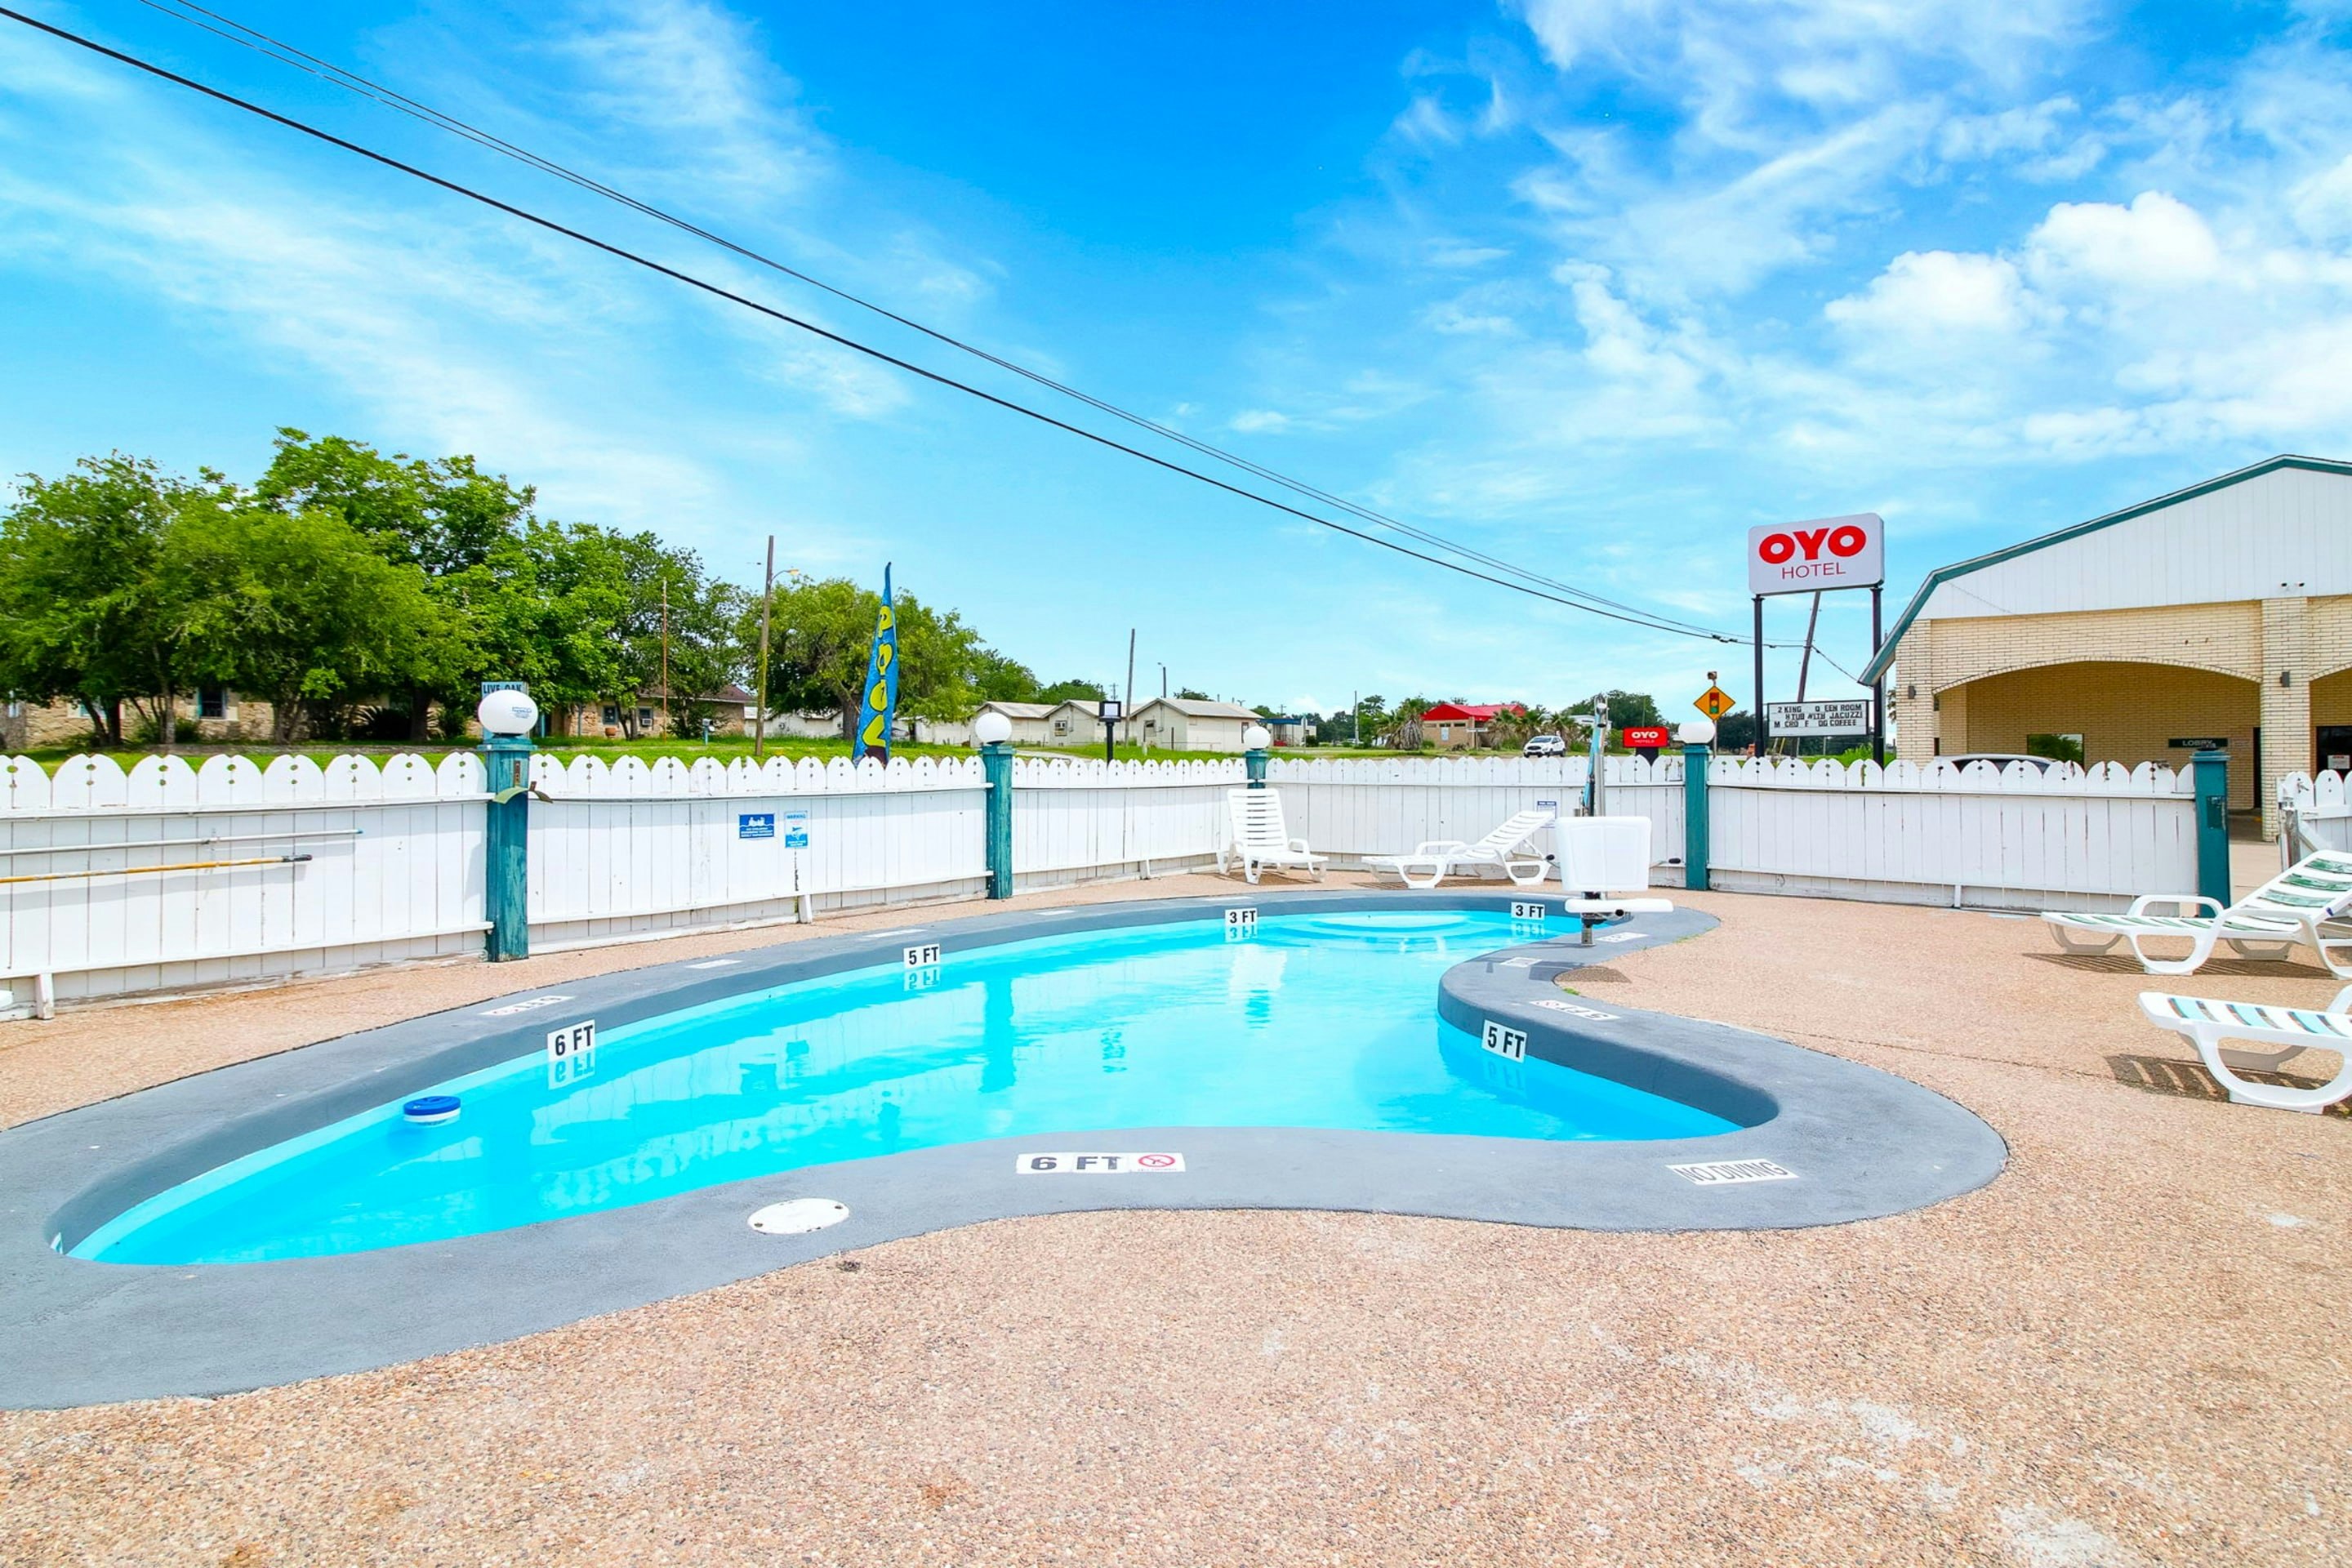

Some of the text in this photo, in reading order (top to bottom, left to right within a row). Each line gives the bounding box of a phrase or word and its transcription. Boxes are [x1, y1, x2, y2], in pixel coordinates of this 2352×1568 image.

[1759, 525, 1866, 564] OYO
[1782, 562, 1846, 580] HOTEL
[483, 684, 500, 694] LIVE
[1631, 731, 1659, 739] OYO
[1230, 911, 1256, 924] 3 FT
[1516, 905, 1544, 918] 3 FT
[909, 947, 938, 964] 5 FT
[555, 1025, 593, 1056] 6 FT
[1487, 1026, 1525, 1058] 5 FT
[1031, 1156, 1122, 1170] 6 FT
[1674, 1161, 1788, 1182] NO DIVING
